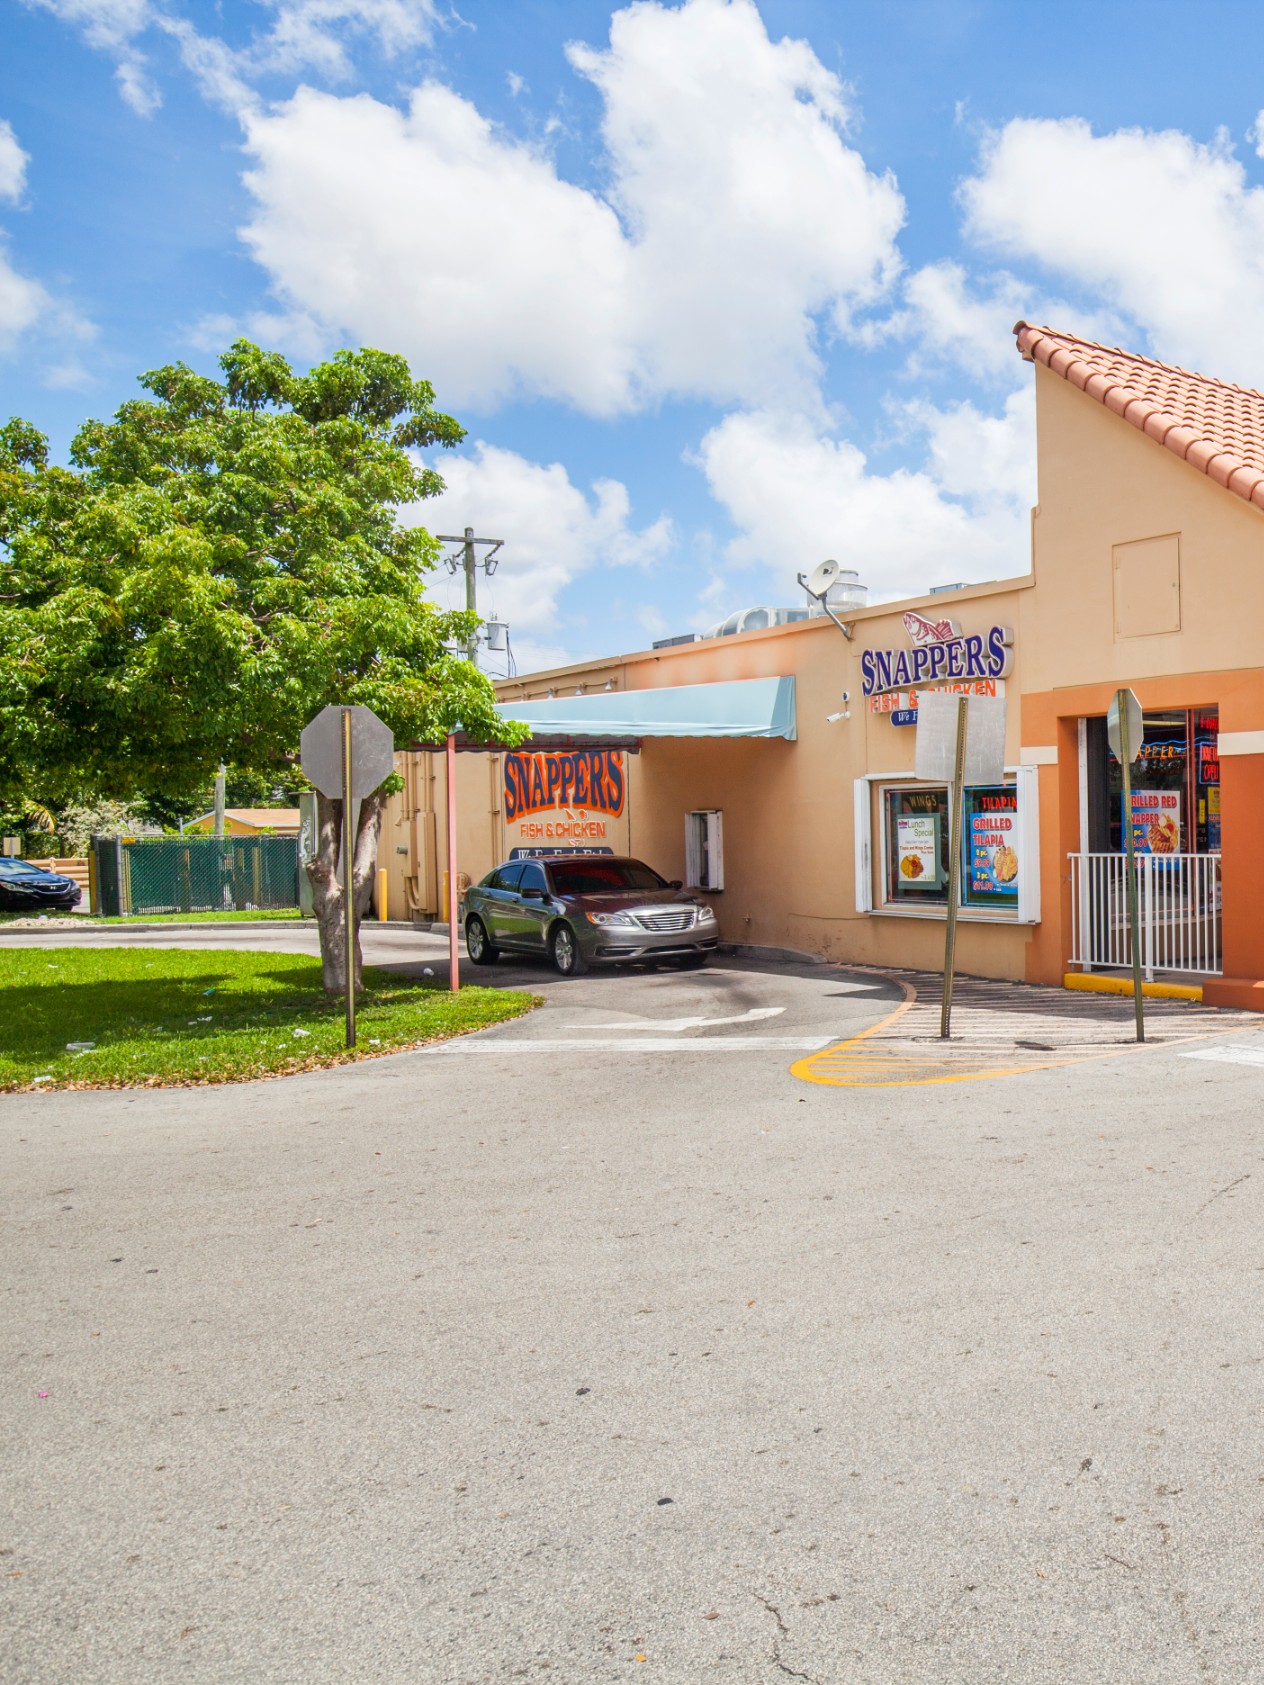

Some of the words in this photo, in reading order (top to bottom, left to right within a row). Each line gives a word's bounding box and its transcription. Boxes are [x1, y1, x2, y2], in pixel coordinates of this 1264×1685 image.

[861, 624, 1008, 697] SNAPPERS
[870, 693, 900, 713] FISH
[504, 751, 625, 822] SNAPPERS
[909, 794, 938, 808] WINGS
[1130, 795, 1160, 808] RILLED
[1161, 795, 1178, 809] RED
[973, 817, 1013, 831] GRILLED
[1131, 812, 1160, 825] NAPPER
[520, 822, 544, 838] FISH
[546, 821, 555, 838] &
[555, 821, 607, 838] CHICKEN
[973, 834, 1004, 848] TILAPIA
